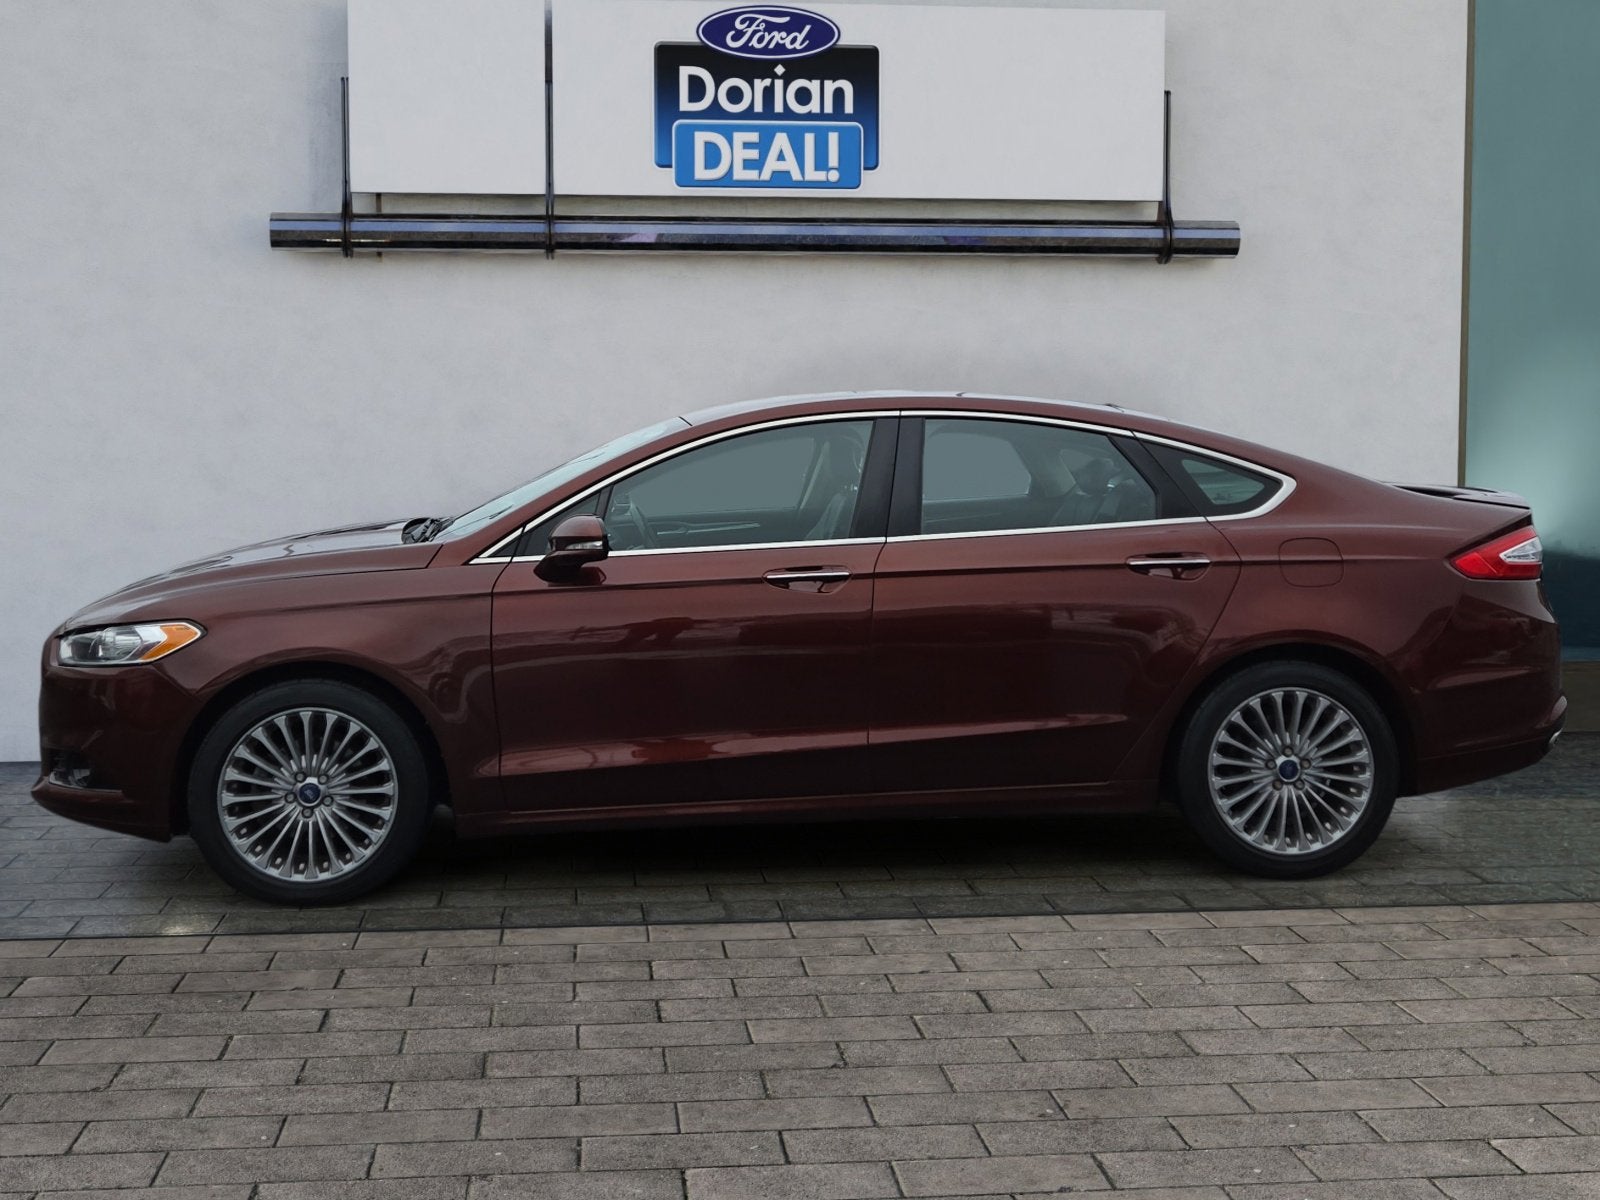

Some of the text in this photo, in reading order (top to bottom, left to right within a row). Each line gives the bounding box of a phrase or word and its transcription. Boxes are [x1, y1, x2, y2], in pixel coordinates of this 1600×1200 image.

[725, 13, 812, 50] Ford
[679, 64, 854, 114] Dorian
[694, 131, 840, 182] DEAL!
